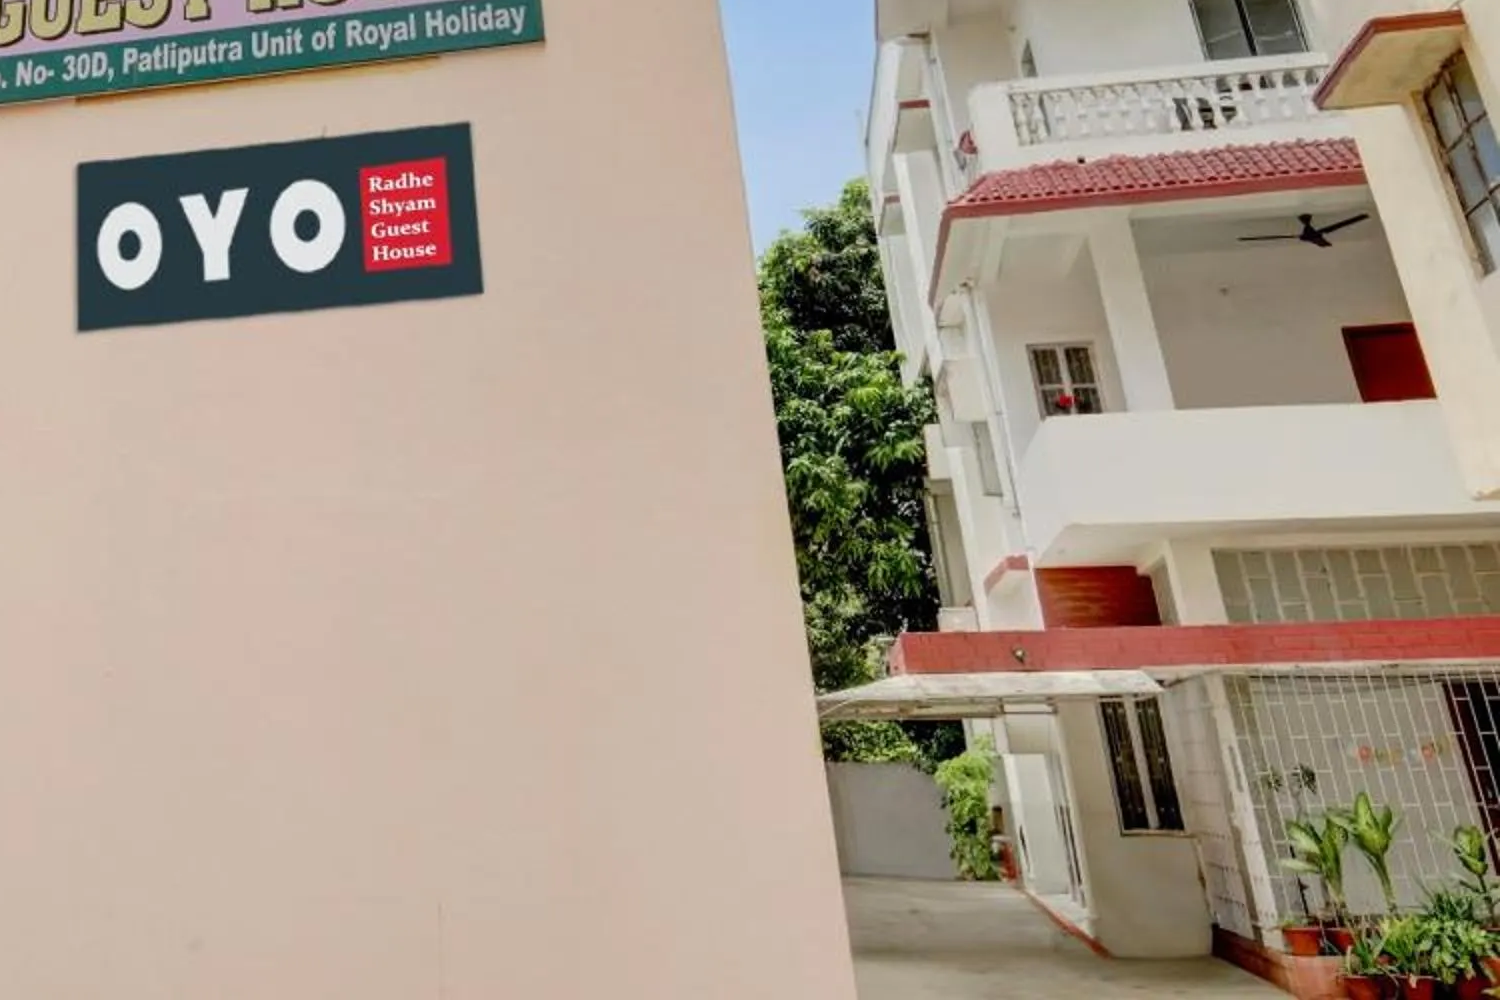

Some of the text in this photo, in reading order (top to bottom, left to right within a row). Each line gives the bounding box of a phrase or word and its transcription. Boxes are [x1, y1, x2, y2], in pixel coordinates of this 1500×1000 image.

[15, 59, 56, 87] No-
[122, 42, 243, 77] Patliputra
[250, 27, 304, 58] Unit
[311, 22, 337, 51] of
[345, 12, 417, 51] Royal
[424, 4, 526, 38] Holiday
[368, 173, 433, 193] Radhe
[369, 196, 437, 218] Shyam
[97, 179, 346, 290] OYO
[371, 219, 430, 238] Guest
[372, 242, 437, 261] House
